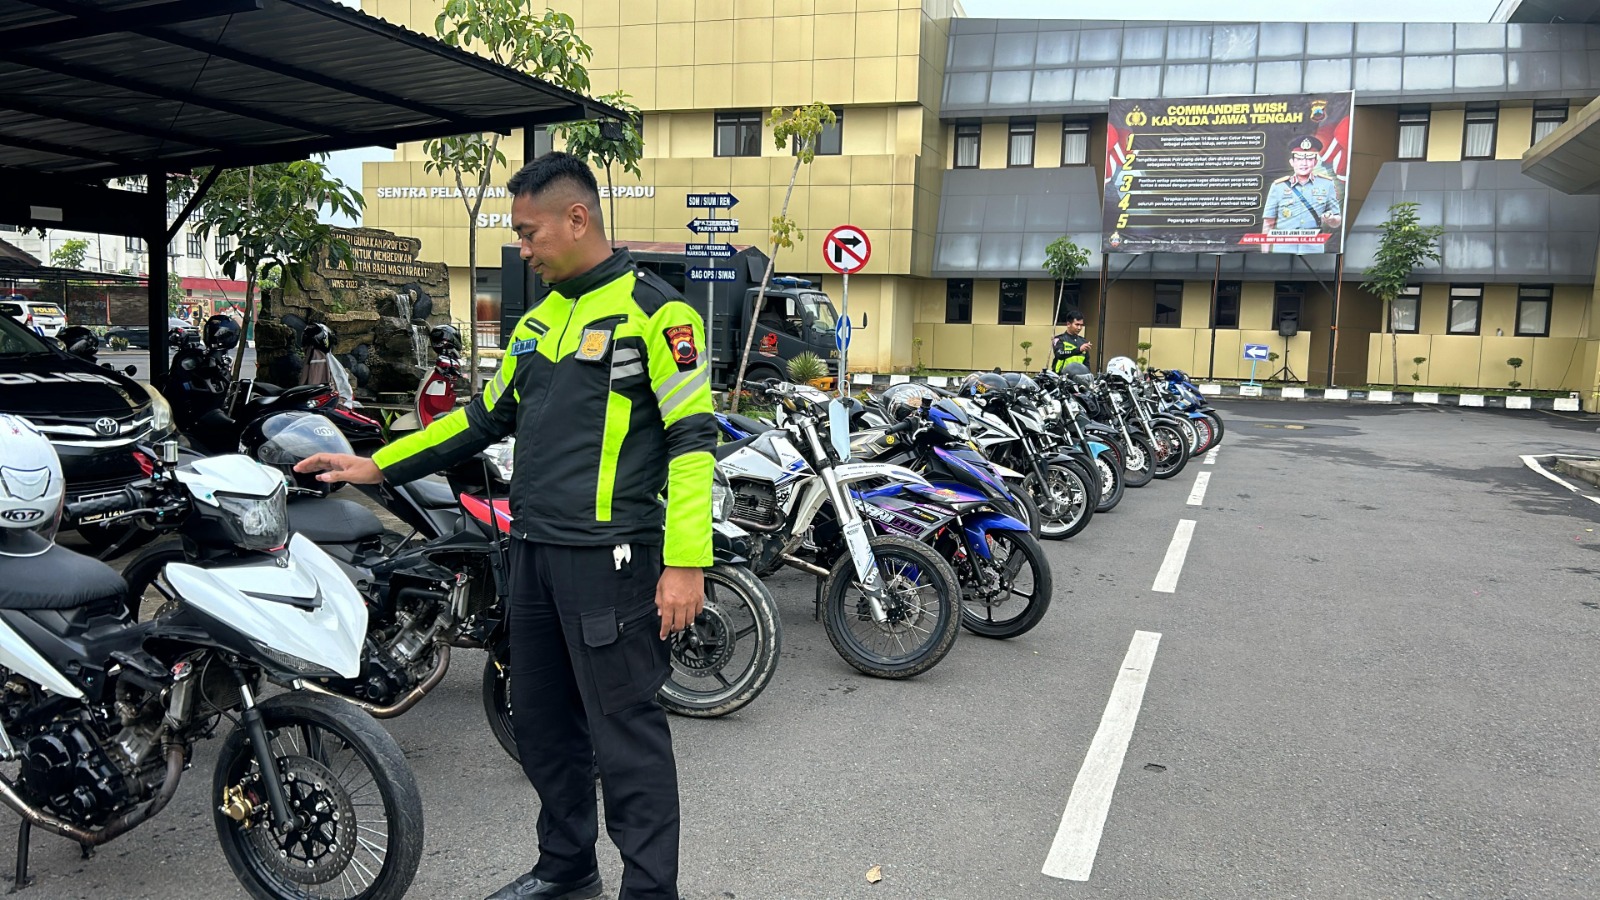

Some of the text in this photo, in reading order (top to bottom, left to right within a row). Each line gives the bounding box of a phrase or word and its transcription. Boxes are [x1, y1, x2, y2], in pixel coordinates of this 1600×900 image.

[1167, 102, 1287, 115] COMMANDER WISH
[1151, 112, 1302, 126] KAPOLDA JAWA TENGAH
[1125, 133, 1135, 151] 1
[1122, 154, 1136, 170] 2
[1120, 174, 1133, 191] 3
[377, 187, 427, 199] SENTRA
[689, 196, 700, 206] SDM
[1117, 193, 1131, 211] 4
[477, 213, 512, 228] SPK
[1116, 213, 1129, 229] 5
[354, 236, 382, 248] GUNAKAN
[383, 239, 409, 251] PROFESI
[374, 250, 412, 263] MEMBERIKAN
[372, 263, 387, 274] BAGI
[691, 270, 702, 279] BAG
[703, 270, 714, 279] OPS
[718, 270, 735, 280] SIWAS
[346, 280, 358, 289] 2023
[865, 567, 880, 584] One
